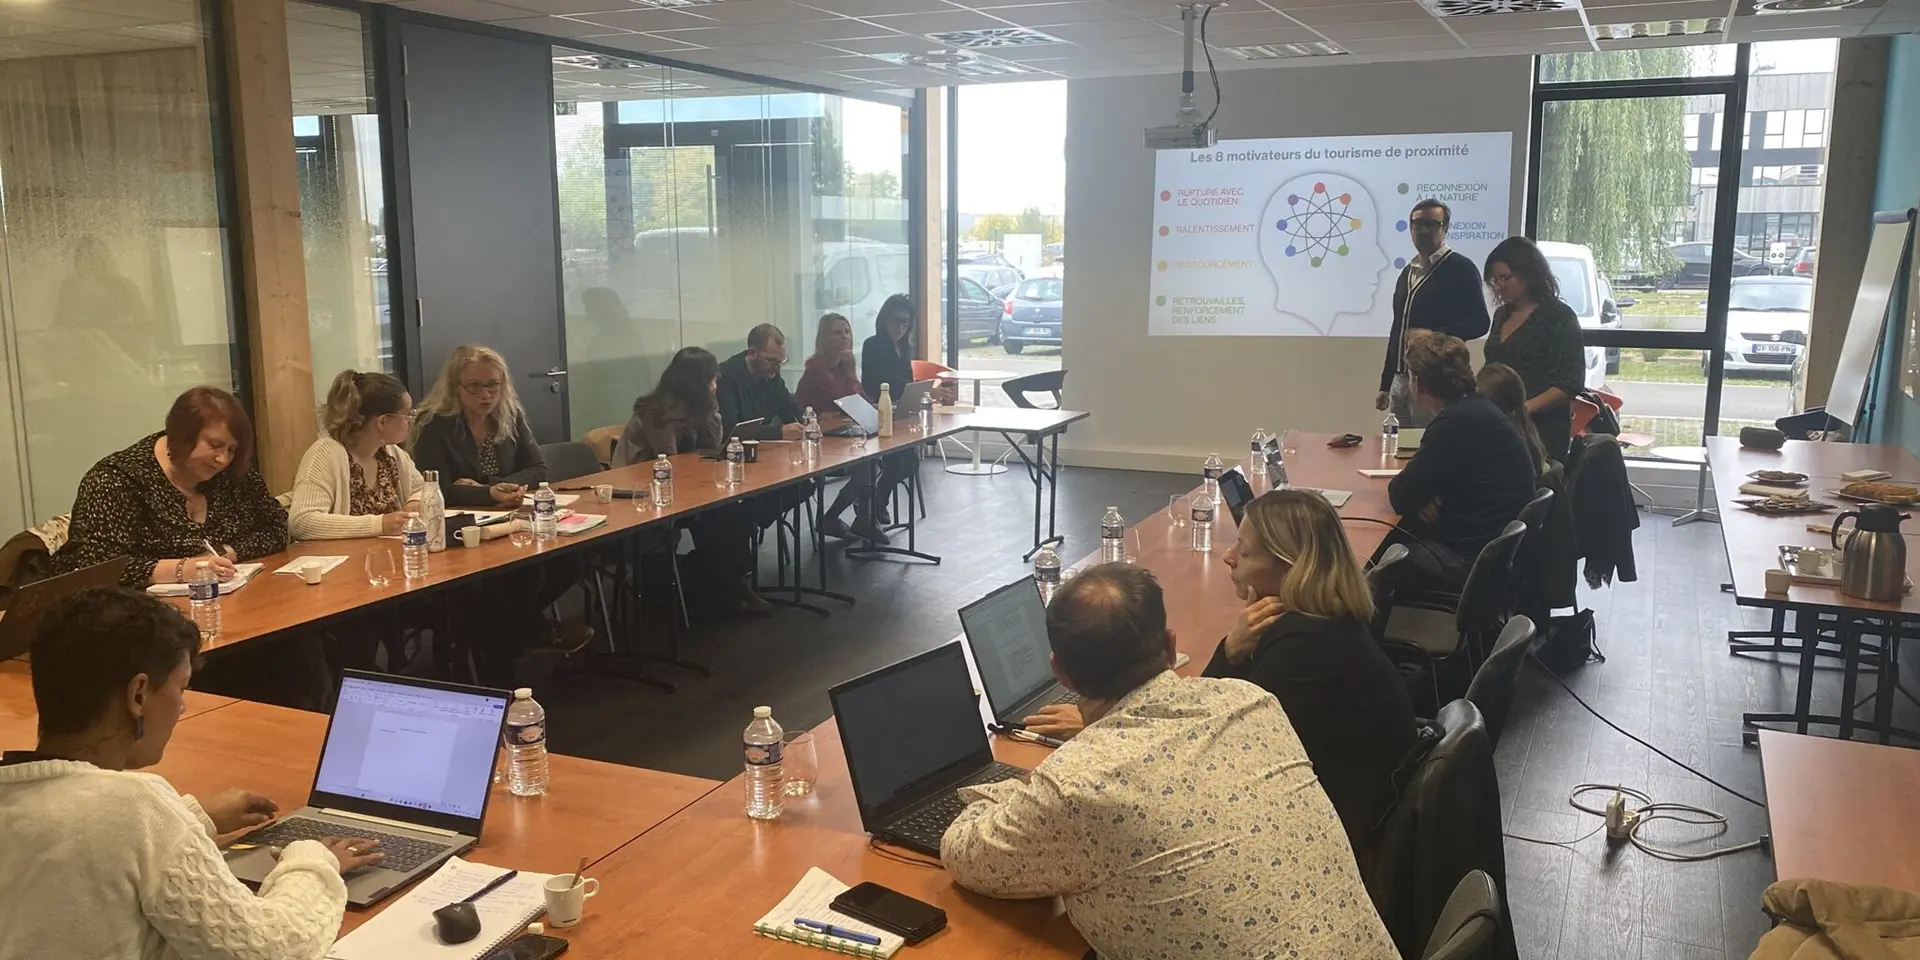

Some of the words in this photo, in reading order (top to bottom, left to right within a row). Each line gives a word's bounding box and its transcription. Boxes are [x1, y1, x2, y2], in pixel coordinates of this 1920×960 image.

[1190, 152, 1213, 163] Les
[1215, 151, 1224, 162] 8
[1227, 149, 1302, 162] motivateurs
[1304, 148, 1321, 160] du
[1324, 147, 1382, 159] tourisme
[1385, 146, 1402, 158] de
[1405, 144, 1470, 159] proximité
[1177, 189, 1218, 197] RUPTURE
[1220, 187, 1244, 196] AVEC
[1416, 183, 1488, 192] RECONNEXION
[1439, 192, 1479, 201] NATURE
[1177, 198, 1189, 206] LE
[1190, 197, 1238, 206] QUOTIDIEN
[1176, 224, 1256, 233] RALENTISSEMENT
[1449, 221, 1486, 230] NEXION
[1447, 231, 1505, 240] NSPIRATION
[1172, 315, 1190, 324] DES
[1191, 315, 1217, 324] LIENS
